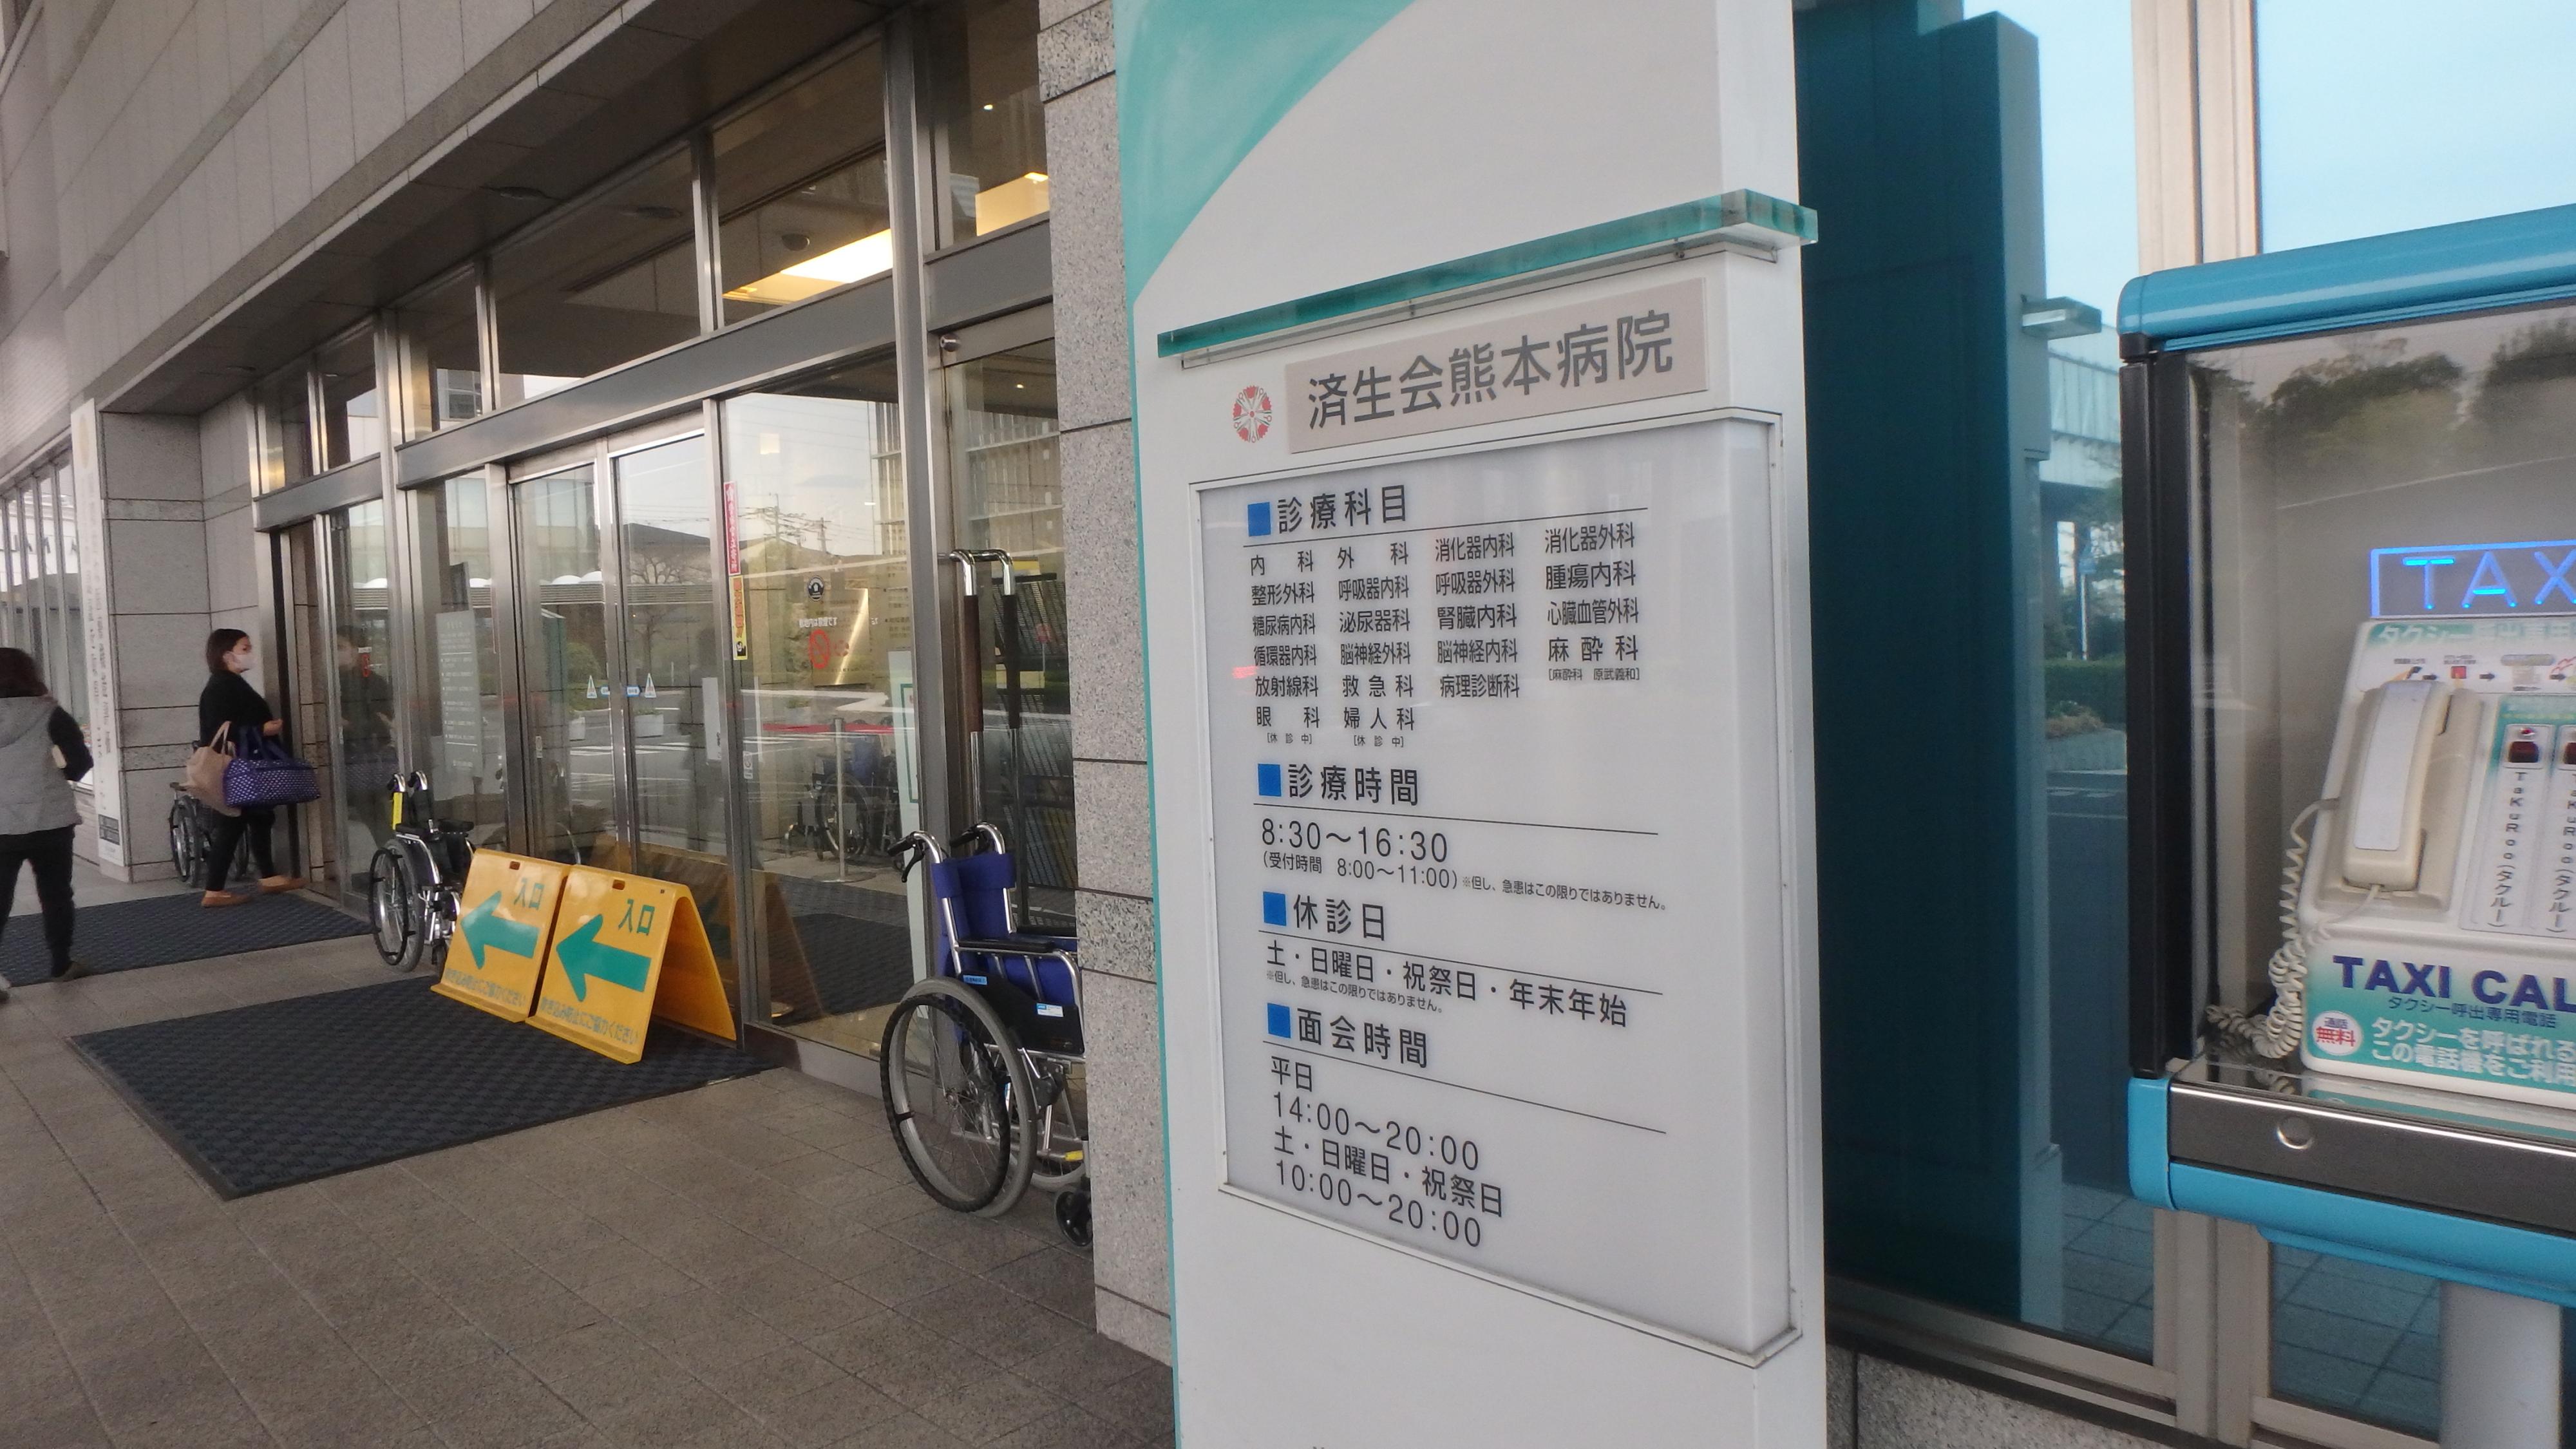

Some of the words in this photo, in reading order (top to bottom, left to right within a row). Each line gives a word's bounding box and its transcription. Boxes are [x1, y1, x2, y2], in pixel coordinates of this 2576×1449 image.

[1309, 309, 1673, 430] 済生会熊本病院
[1277, 484, 1406, 534] 診療科目
[1435, 533, 1515, 563] 消化器内科
[1545, 522, 1635, 554] 消化器外科
[1338, 575, 1410, 602] 呼吸器内科
[1435, 567, 1516, 596] 呼吸器外科
[1546, 560, 1636, 591] 腫瘍内科
[1251, 581, 1315, 606] 整形外科
[1253, 612, 1316, 637] 糖尿病内科
[1340, 609, 1410, 633] 泌尿器科
[1437, 603, 1517, 630] 腎臓内科
[1547, 598, 1639, 626] 心臓血管外科
[1253, 644, 1318, 667] 循環器内科
[1340, 641, 1411, 666] 脳神経外科
[1437, 637, 1518, 665] 脳神経内科
[1548, 634, 1639, 662] 麻酔科
[1255, 675, 1319, 697] 放射線科
[1342, 674, 1414, 697] 救急科
[1439, 673, 1520, 698] 病理診断科
[1343, 706, 1414, 731] 婦人科
[1288, 763, 1419, 807] 診療時間
[514, 877, 545, 911] 入口
[618, 898, 655, 936] 入口
[1293, 894, 1386, 942] 休診日
[2333, 954, 2452, 998] TAXI
[2389, 996, 2557, 1029] タクシー呼出専用電話
[1298, 1007, 1428, 1068] 面会時間
[2316, 1027, 2356, 1046] 無料
[1271, 1056, 1312, 1093] 平日
[1274, 1126, 1502, 1218] 土・日曜日・祝祭日
